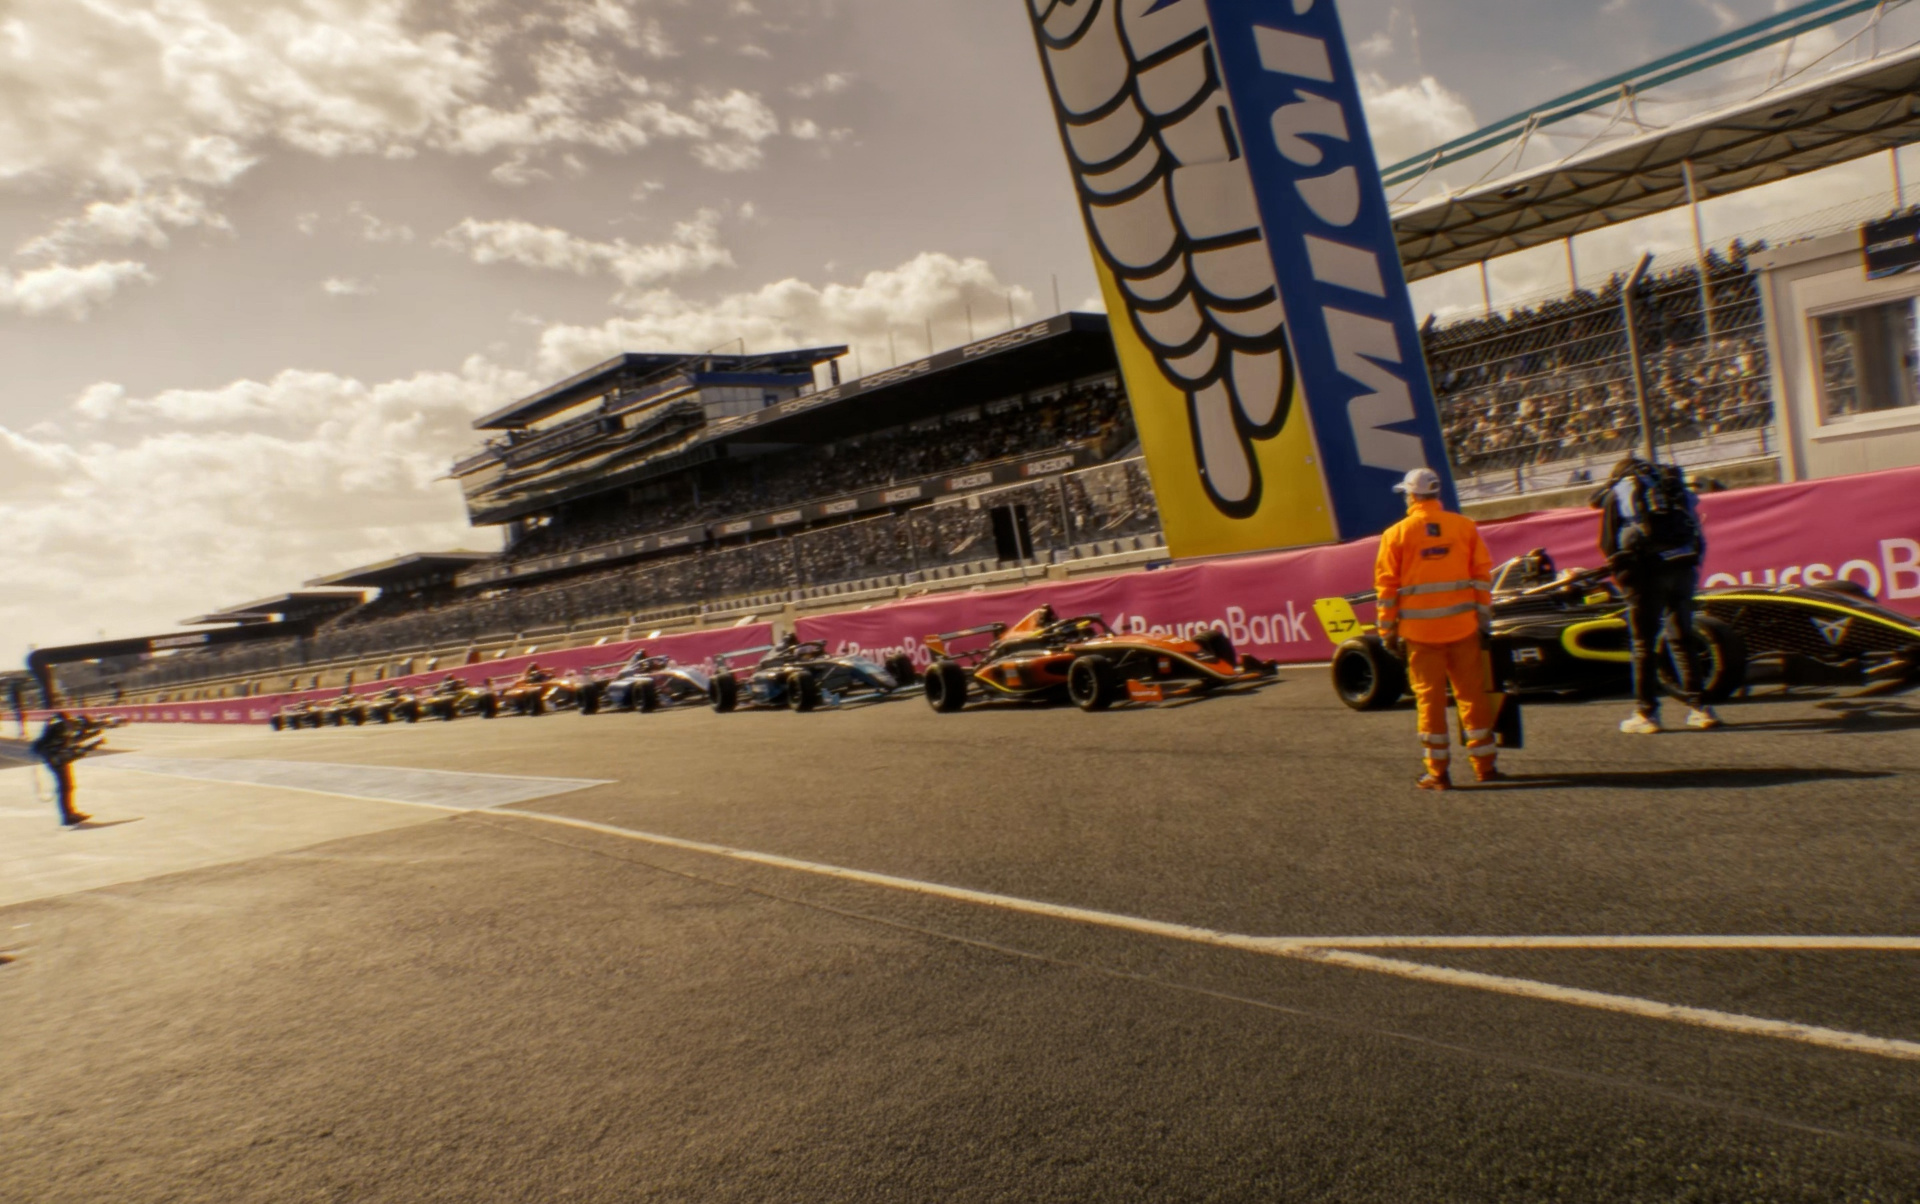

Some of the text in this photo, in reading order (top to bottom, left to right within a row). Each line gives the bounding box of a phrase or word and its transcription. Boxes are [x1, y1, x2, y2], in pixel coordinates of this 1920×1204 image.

[962, 322, 1049, 358] PORSCHE
[859, 359, 931, 389] PORSCHE
[780, 388, 841, 414] PORSCHE
[707, 413, 758, 437] PORSCHE
[1328, 618, 1356, 634] 17
